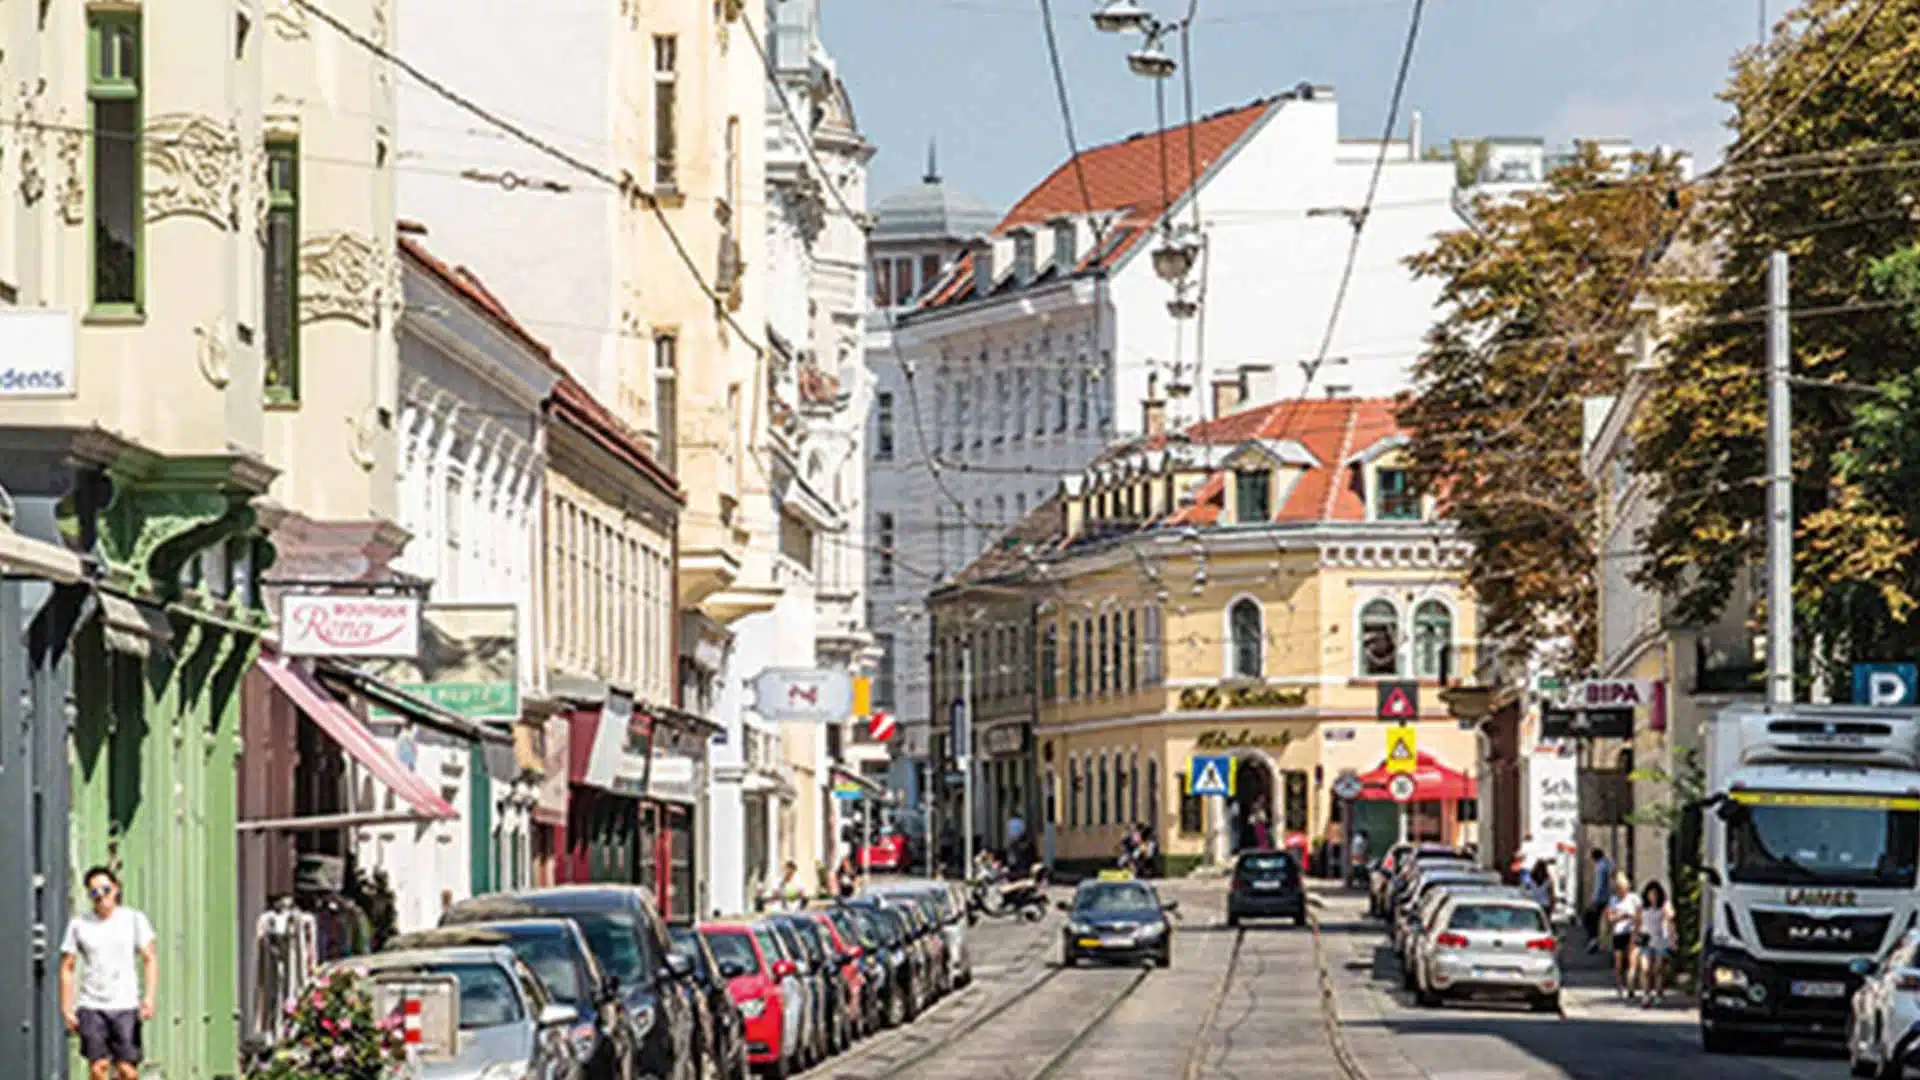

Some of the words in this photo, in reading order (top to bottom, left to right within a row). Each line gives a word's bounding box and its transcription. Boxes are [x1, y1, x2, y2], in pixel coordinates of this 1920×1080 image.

[334, 603, 407, 618] BOUTIQUE
[1587, 683, 1640, 703] BIPA
[1870, 672, 1907, 706] P
[1788, 926, 1853, 940] MAN
